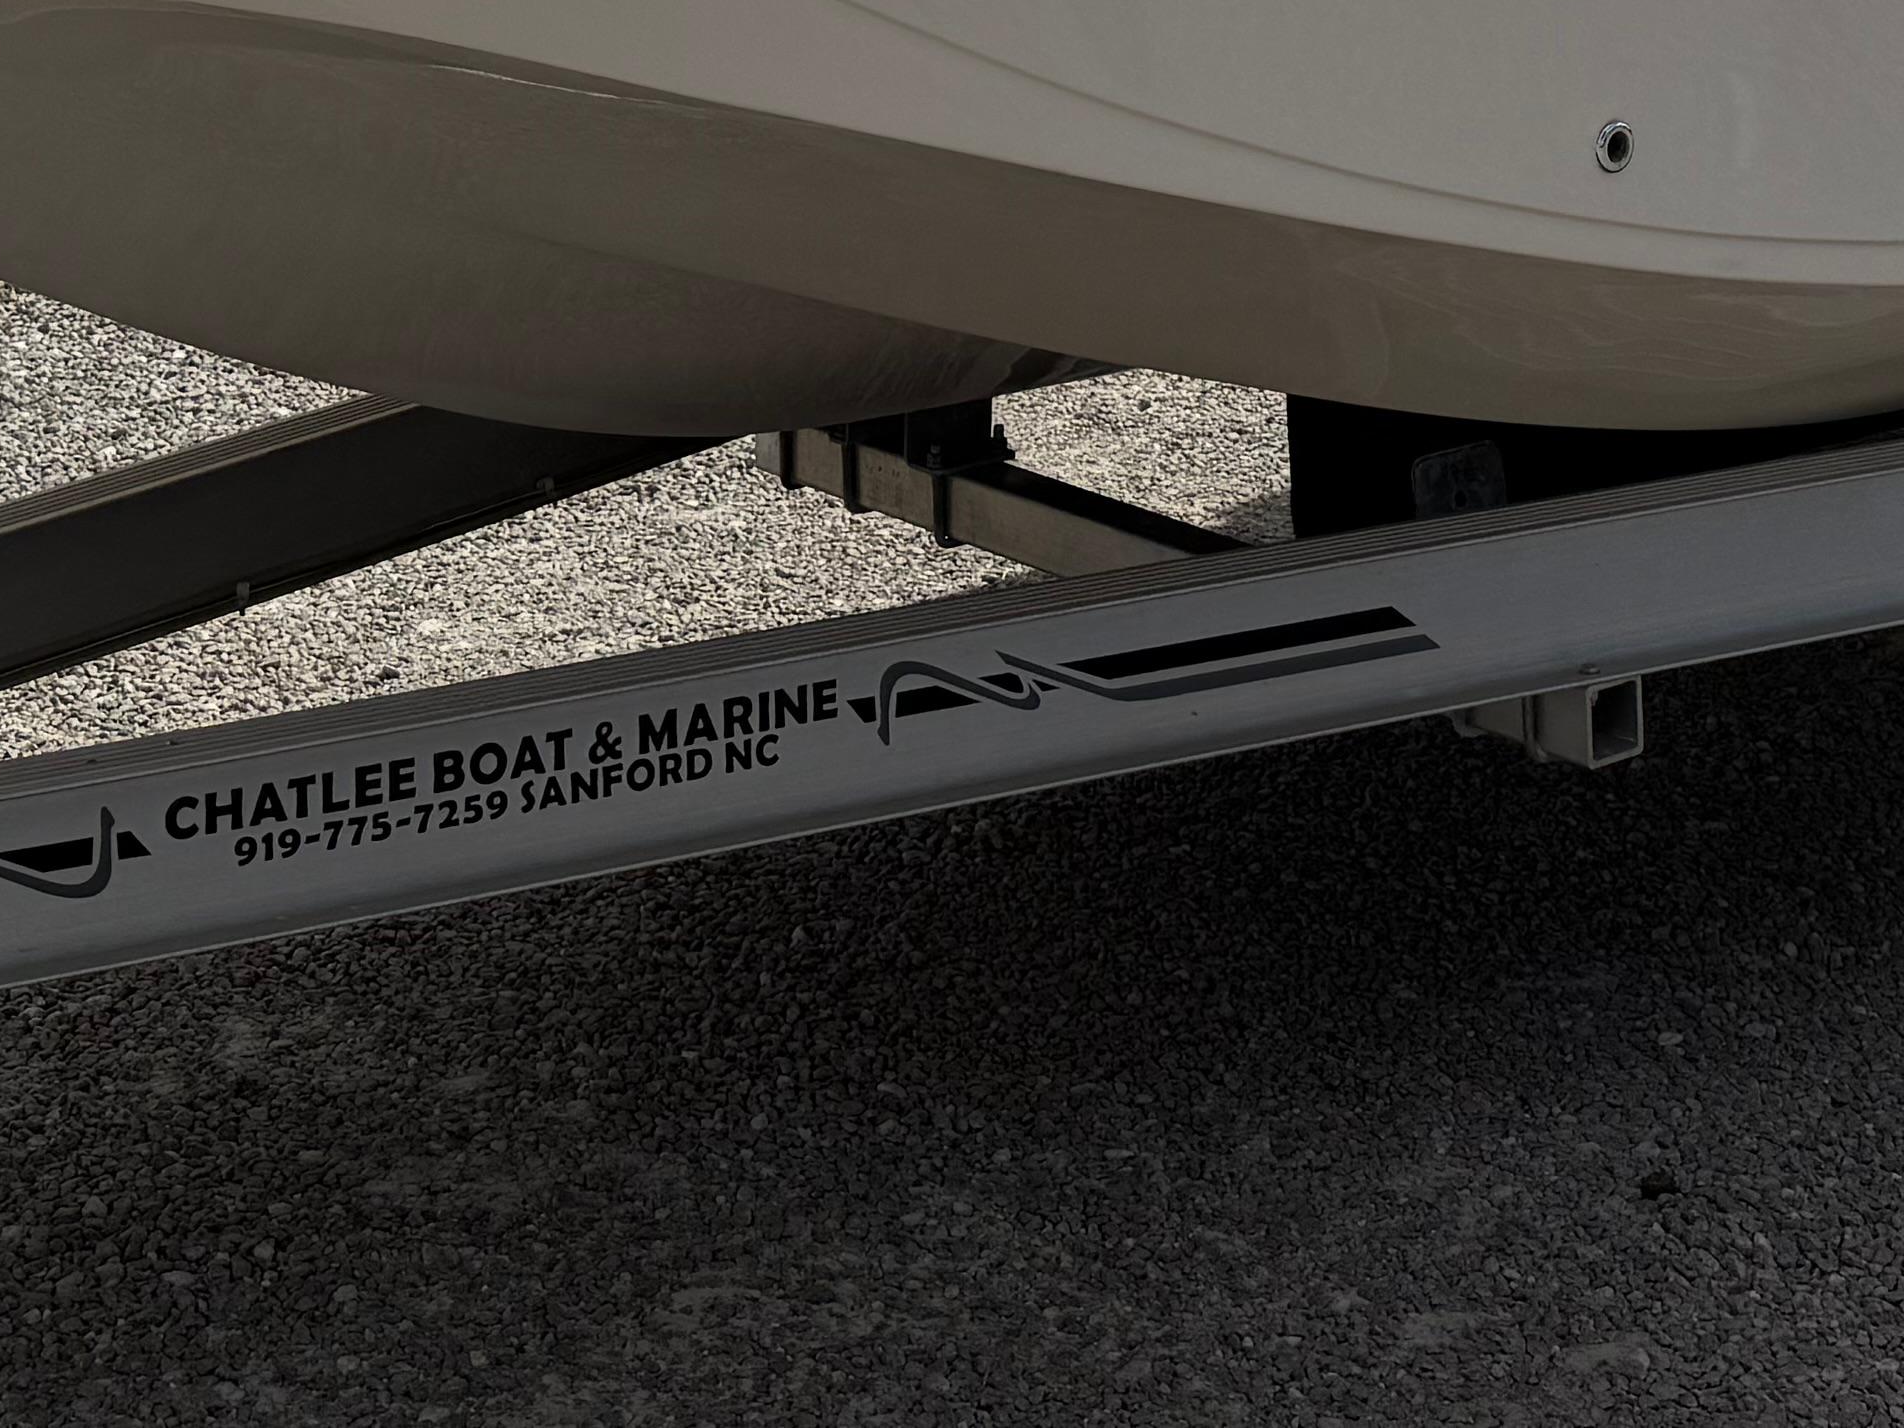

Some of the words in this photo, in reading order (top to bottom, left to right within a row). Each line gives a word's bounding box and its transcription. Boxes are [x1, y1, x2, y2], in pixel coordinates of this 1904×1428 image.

[164, 756, 417, 840] CHATLEE
[433, 728, 573, 794] BOAT
[588, 721, 623, 765] &
[638, 678, 839, 755] MARINE
[233, 789, 508, 866] 919-775-7259
[521, 747, 713, 813] SANFORD
[725, 734, 780, 774] NC
